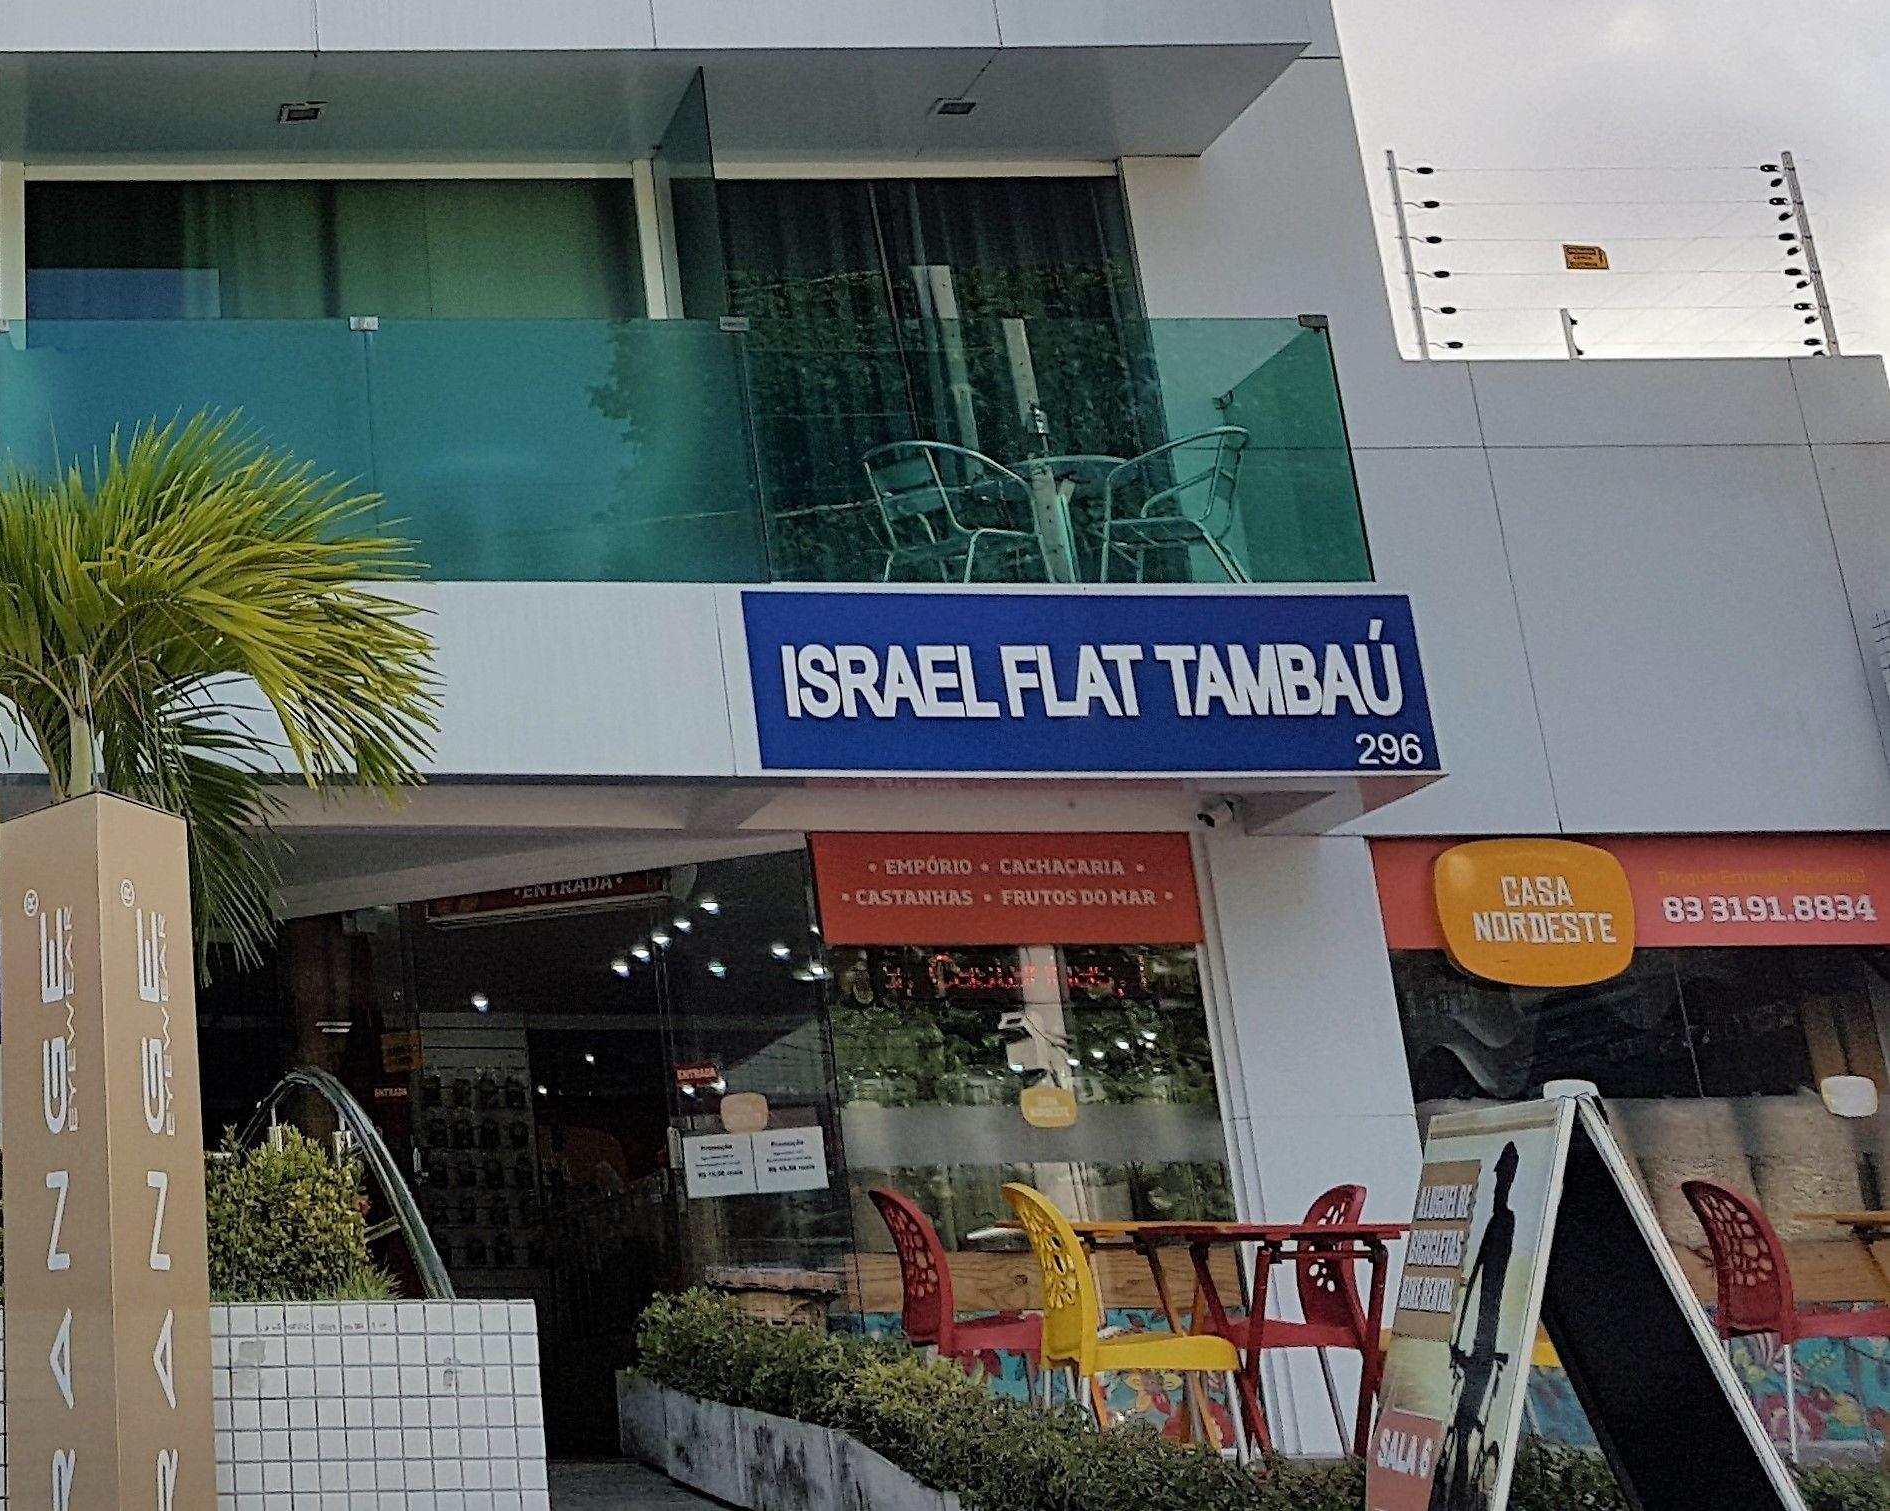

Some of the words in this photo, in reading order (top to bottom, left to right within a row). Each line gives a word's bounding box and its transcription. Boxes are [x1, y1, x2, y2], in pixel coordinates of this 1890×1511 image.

[780, 644, 1003, 719] ISRAEL
[1003, 643, 1143, 719] FLAT
[1152, 618, 1403, 718] TAMBAÚ
[1355, 732, 1424, 767] 296
[884, 855, 972, 876] EMPÓRIO
[999, 858, 1125, 879] CACHAÇARIA
[855, 890, 974, 906] CASTANHAS
[1002, 890, 1078, 906] FRUTOS
[1081, 891, 1108, 906] DO
[1111, 890, 1157, 906] MAR
[1500, 875, 1574, 907] CASA
[1662, 895, 1706, 923] 83
[1710, 894, 1878, 923] 3191.8834
[1472, 911, 1617, 944] NORDESTE
[62, 906, 79, 1132] EYEWEAR
[158, 913, 176, 1137] EYEWEAR
